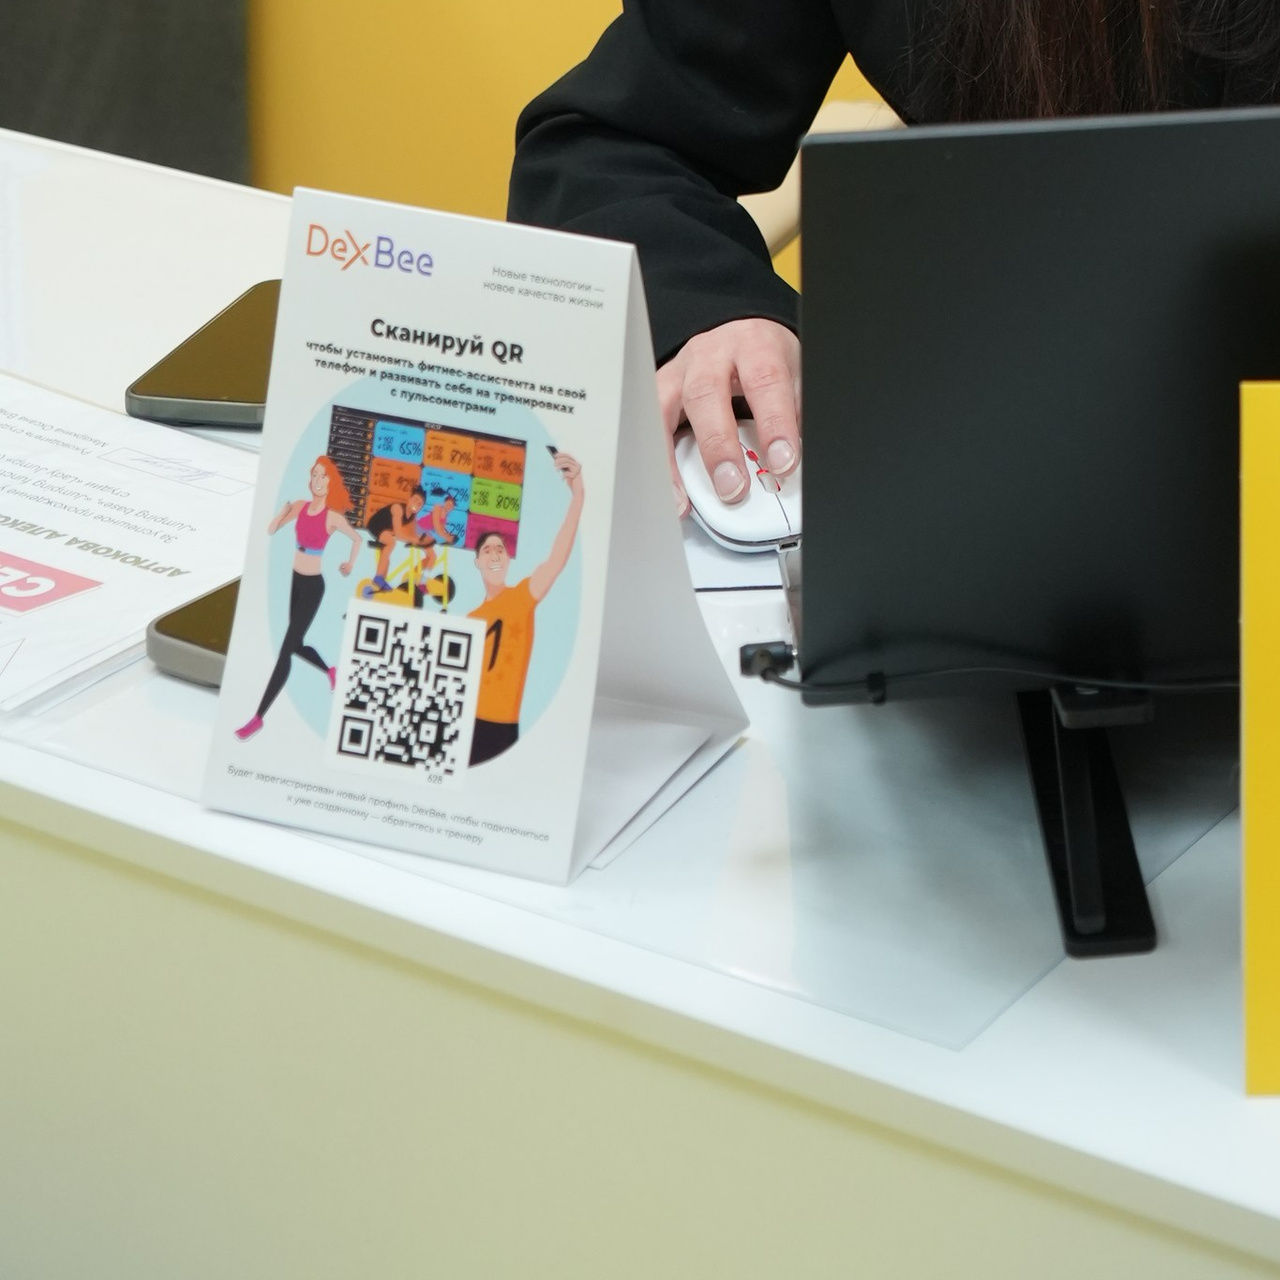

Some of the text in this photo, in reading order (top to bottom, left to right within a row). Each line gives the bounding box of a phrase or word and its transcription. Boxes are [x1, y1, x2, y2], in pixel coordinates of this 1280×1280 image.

[483, 282, 604, 310] новое качество жизни
[492, 267, 527, 282] Новые
[530, 274, 592, 292] технологии
[371, 318, 524, 365] Сканируй QR
[306, 341, 587, 400] чтобы установить фитнес-ассистента на свой
[315, 359, 575, 414] телефон и развивать себя на тренировках
[390, 388, 497, 415] с пульсометрами
[64, 536, 191, 577] АРТЮКОВА
[427, 773, 443, 785] 628
[227, 765, 253, 778] Будет
[255, 772, 334, 795] зарегистрирован
[336, 789, 366, 803] новый
[368, 795, 409, 812] профиль
[450, 814, 479, 828] чтобы
[481, 821, 550, 842] подключиться
[294, 797, 312, 807] уже
[313, 800, 369, 820] созданному
[381, 814, 434, 834] обратитесь
[444, 828, 484, 845] тренеру
